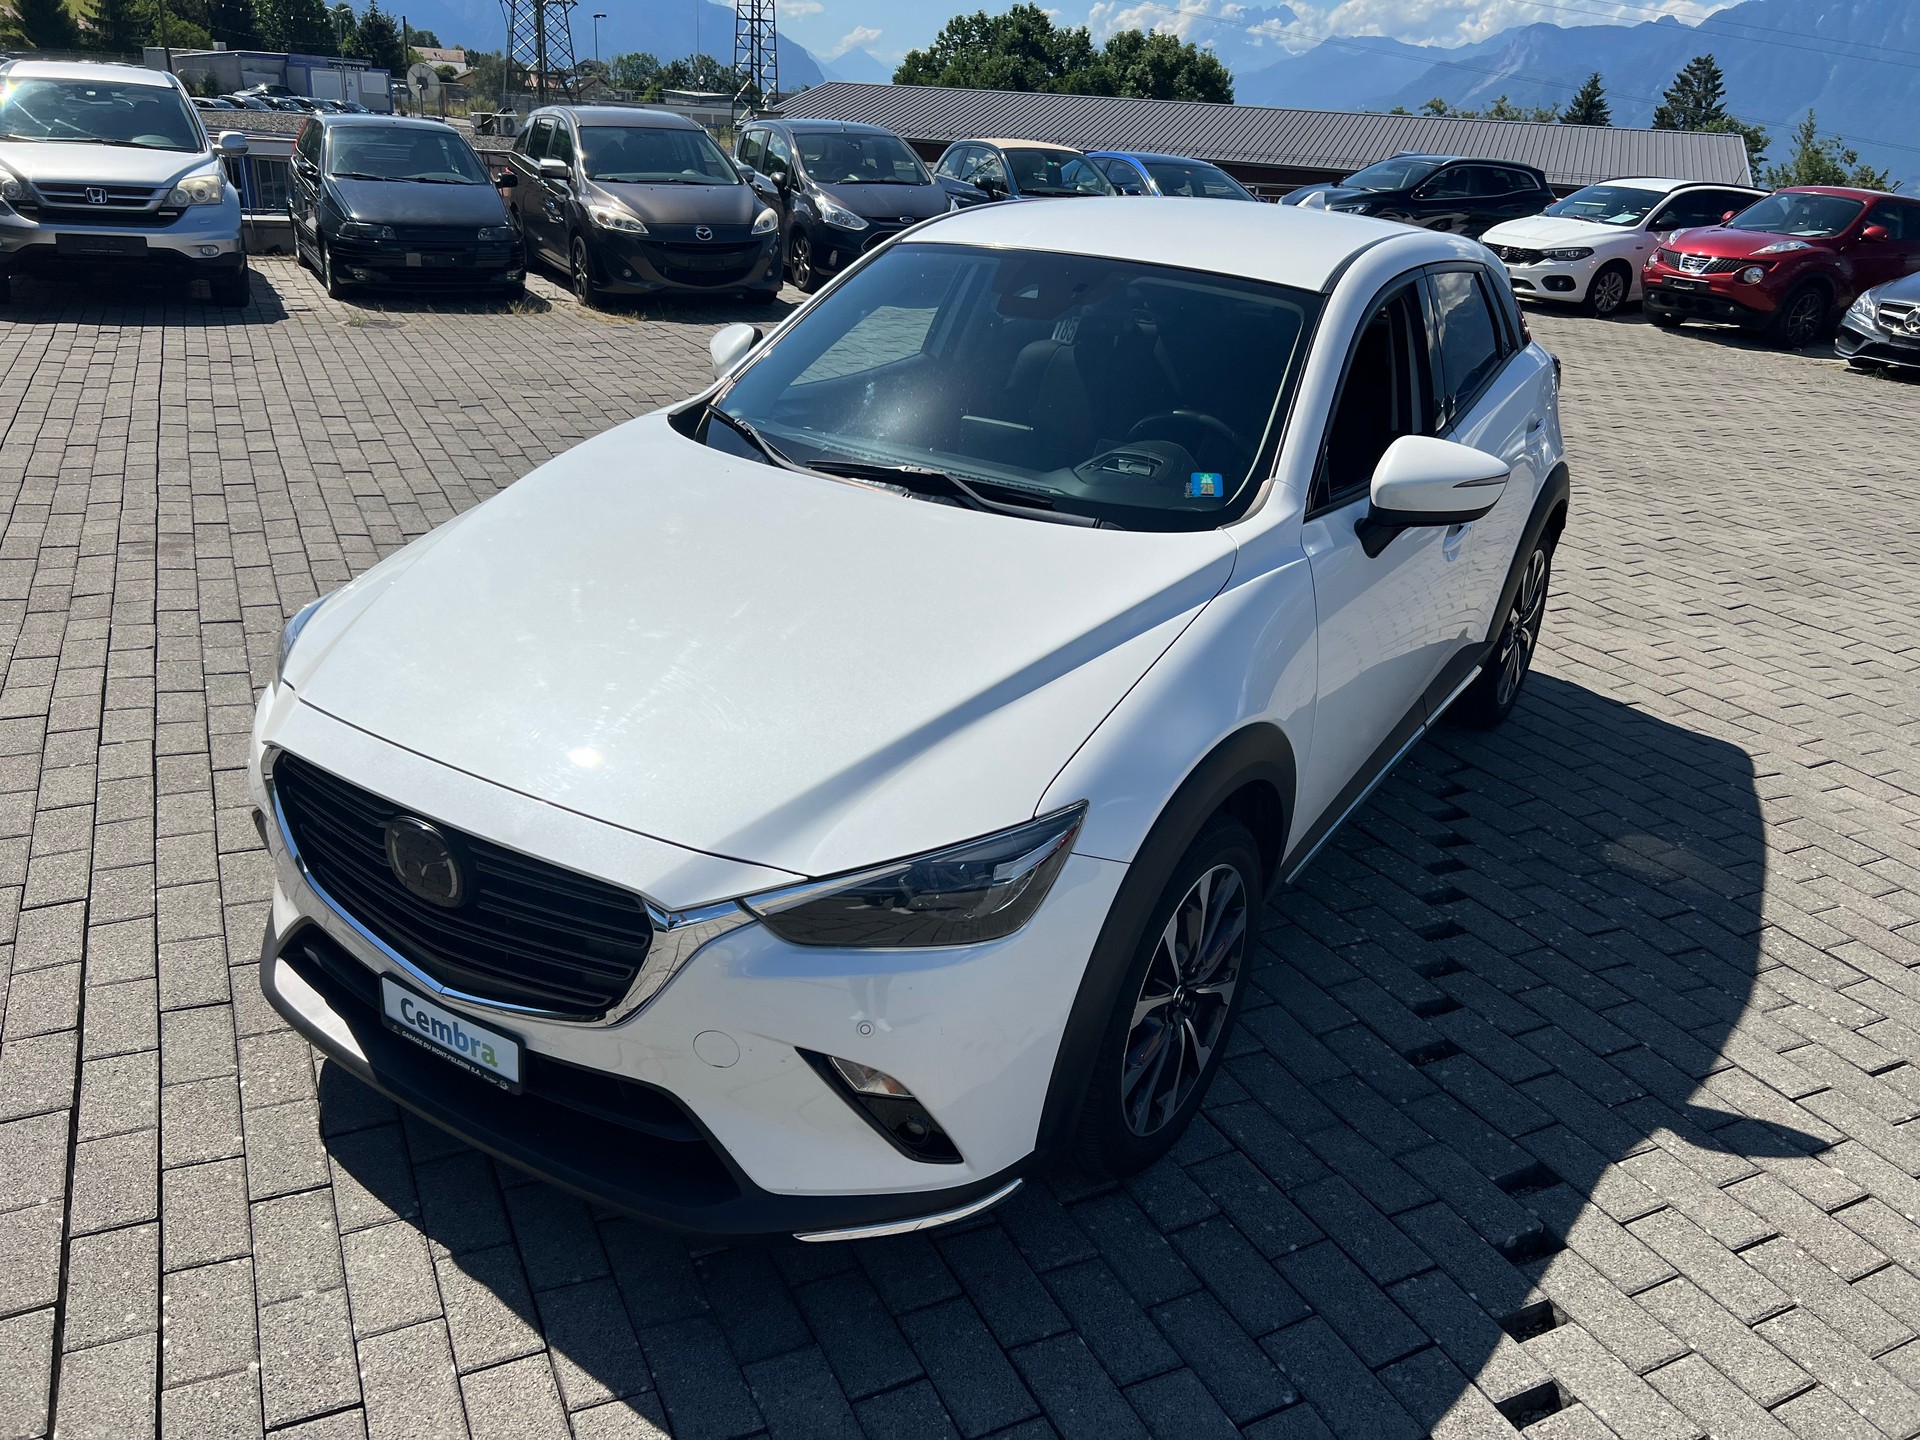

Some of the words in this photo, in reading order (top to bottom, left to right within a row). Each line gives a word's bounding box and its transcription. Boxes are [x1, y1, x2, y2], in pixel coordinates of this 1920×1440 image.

[1200, 483, 1214, 494] 26
[400, 998, 498, 1068] Cembra
[402, 1030, 423, 1046] GARAGE
[423, 1041, 432, 1050] DU
